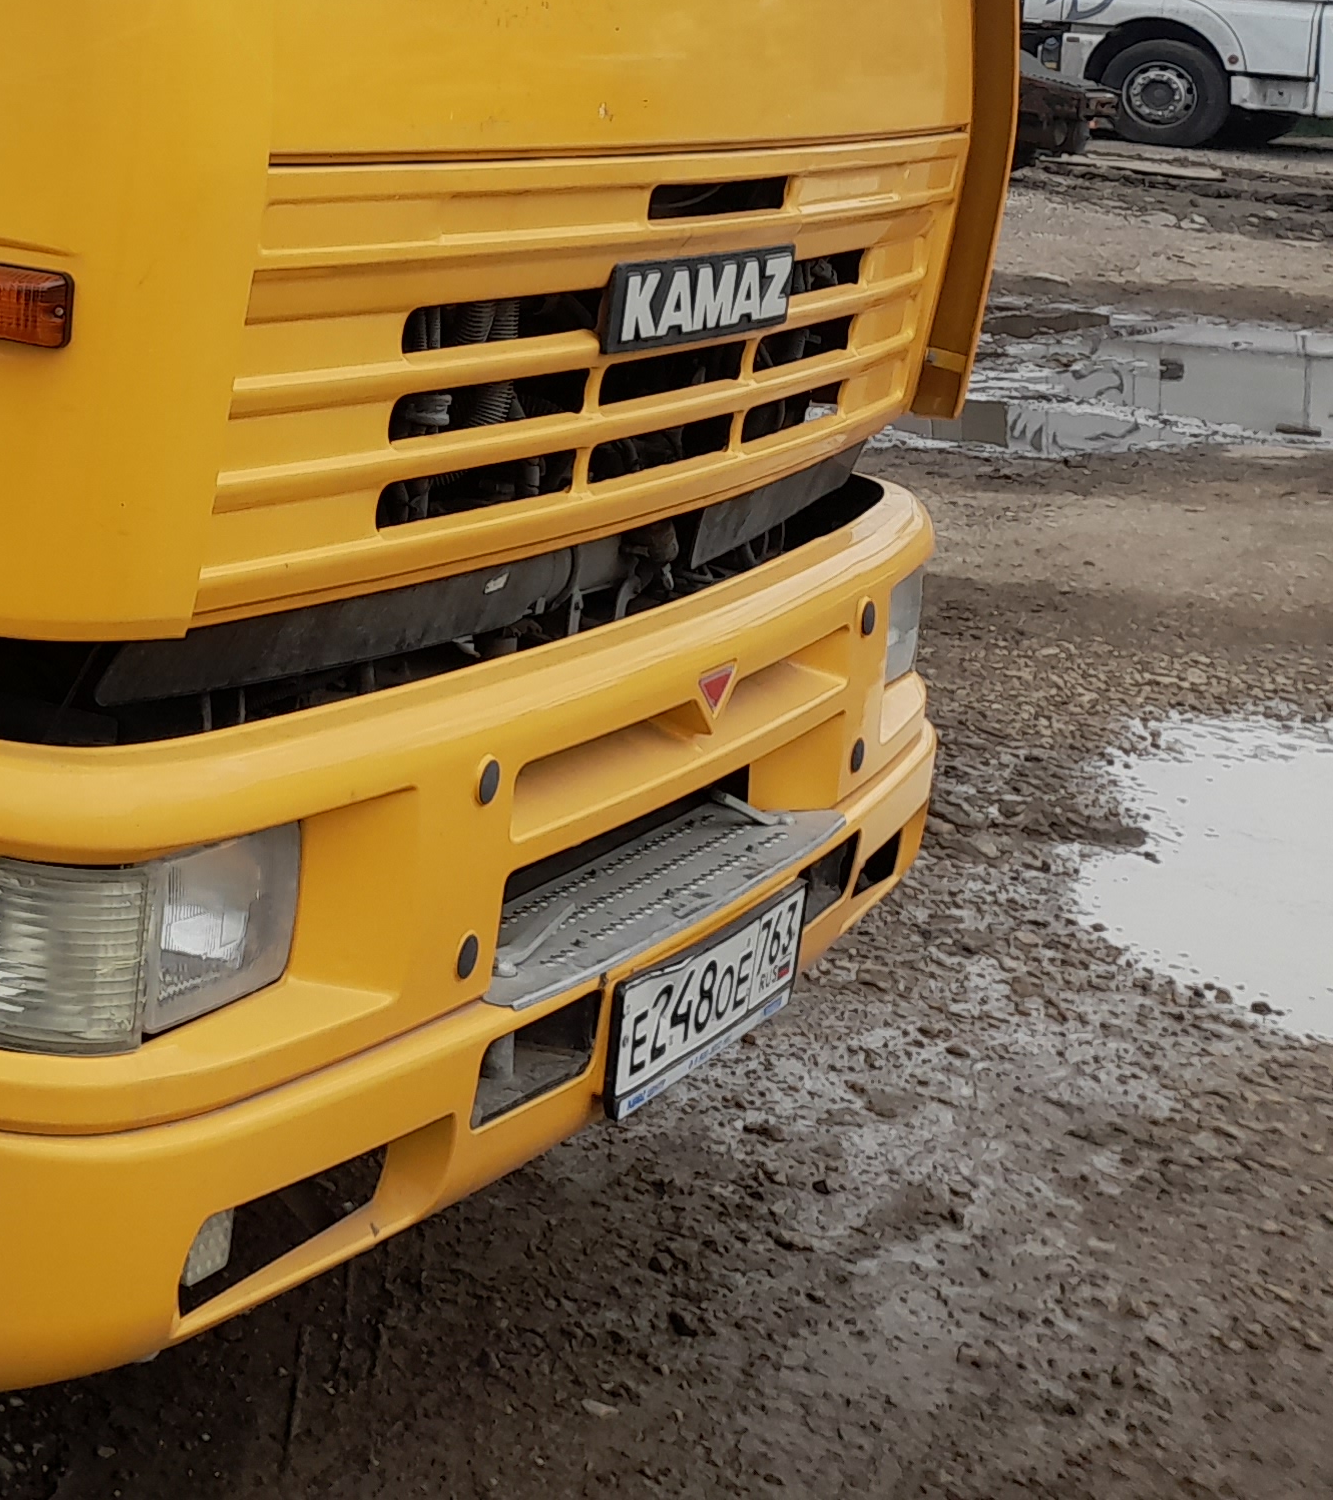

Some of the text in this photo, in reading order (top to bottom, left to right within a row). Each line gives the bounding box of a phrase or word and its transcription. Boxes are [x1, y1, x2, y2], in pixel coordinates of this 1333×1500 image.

[621, 252, 793, 342] KAMAZ
[756, 900, 798, 976] 763
[758, 965, 778, 993] RUS
